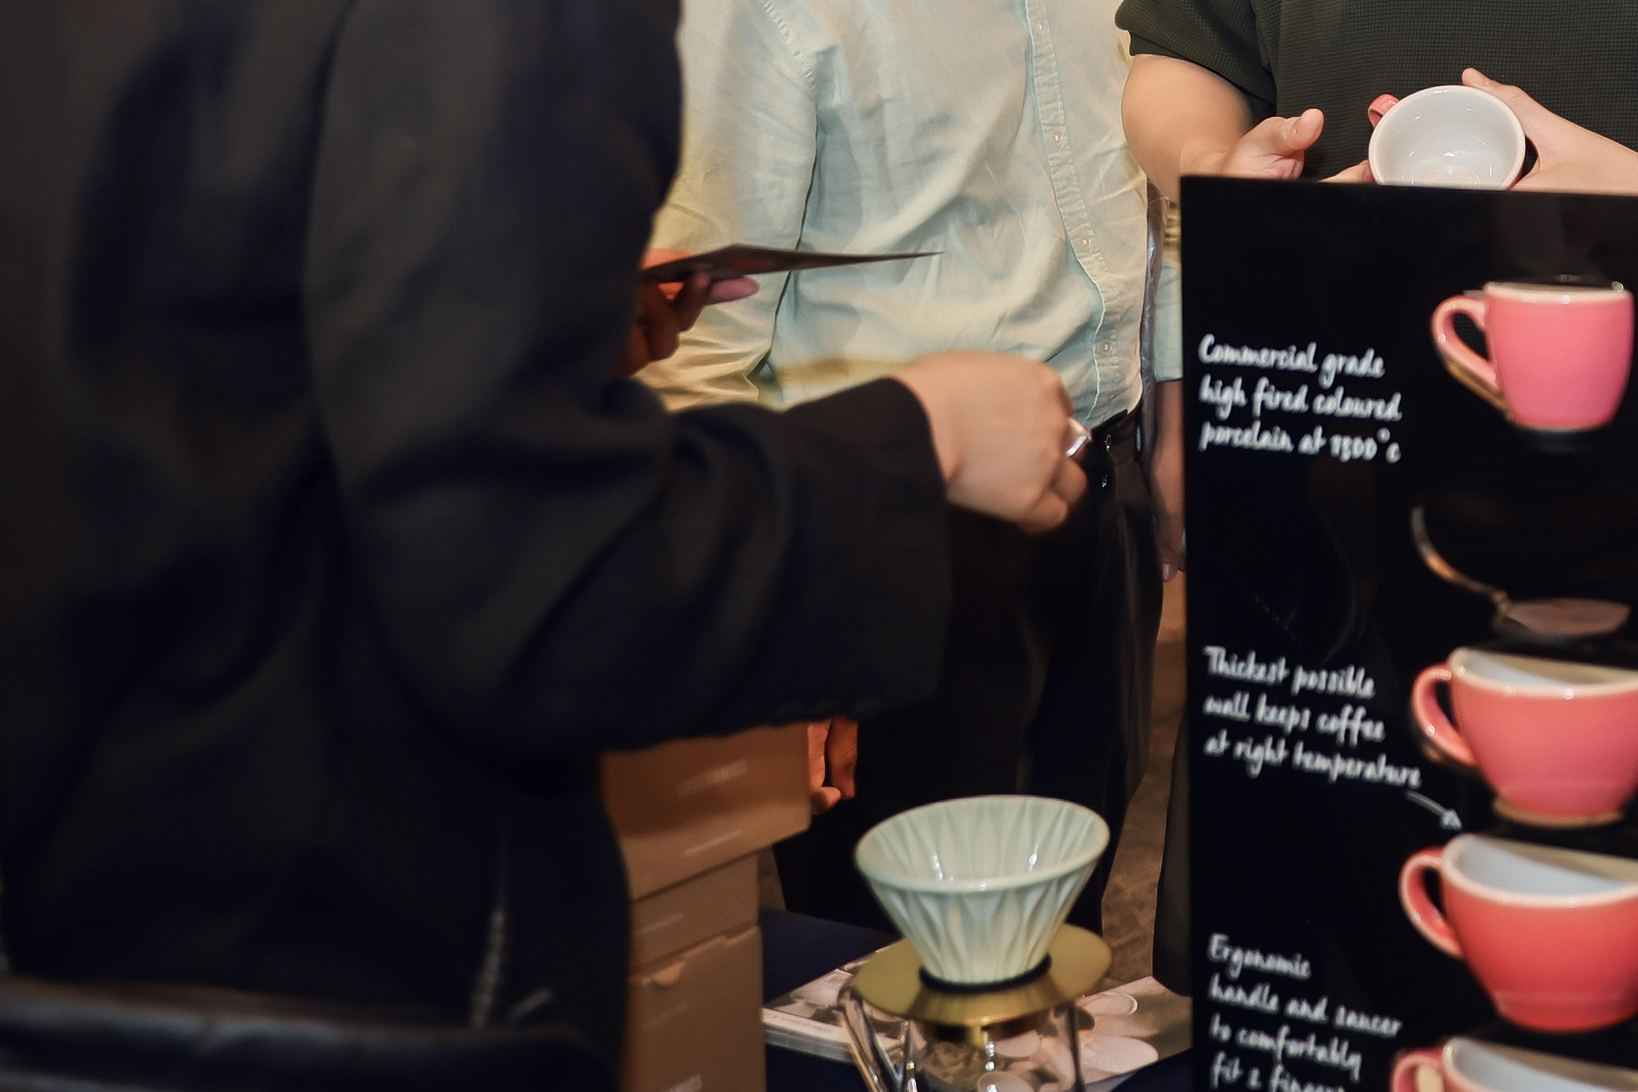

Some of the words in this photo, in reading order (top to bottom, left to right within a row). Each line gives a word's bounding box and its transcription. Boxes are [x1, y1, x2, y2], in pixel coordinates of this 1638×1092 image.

[1199, 333, 1318, 373] Commercial
[1319, 348, 1385, 389] grade
[1199, 374, 1248, 420] high
[1253, 376, 1309, 418] fired
[1312, 386, 1403, 421] coloured
[1199, 420, 1294, 452] porcelain
[1298, 425, 1327, 454] at
[1203, 646, 1289, 684] Thickest
[1292, 665, 1375, 698] possible
[1254, 693, 1311, 734] keeps
[1316, 704, 1385, 746] coffee
[1204, 729, 1230, 754] at
[1234, 736, 1289, 776] right
[1293, 741, 1421, 788] temperature
[1208, 933, 1310, 979] Ergonomic
[1209, 973, 1279, 1012] handle
[1285, 996, 1328, 1022] and
[1210, 1013, 1231, 1041] to
[1237, 1025, 1362, 1081] comfortably
[1211, 1052, 1242, 1087] fit
